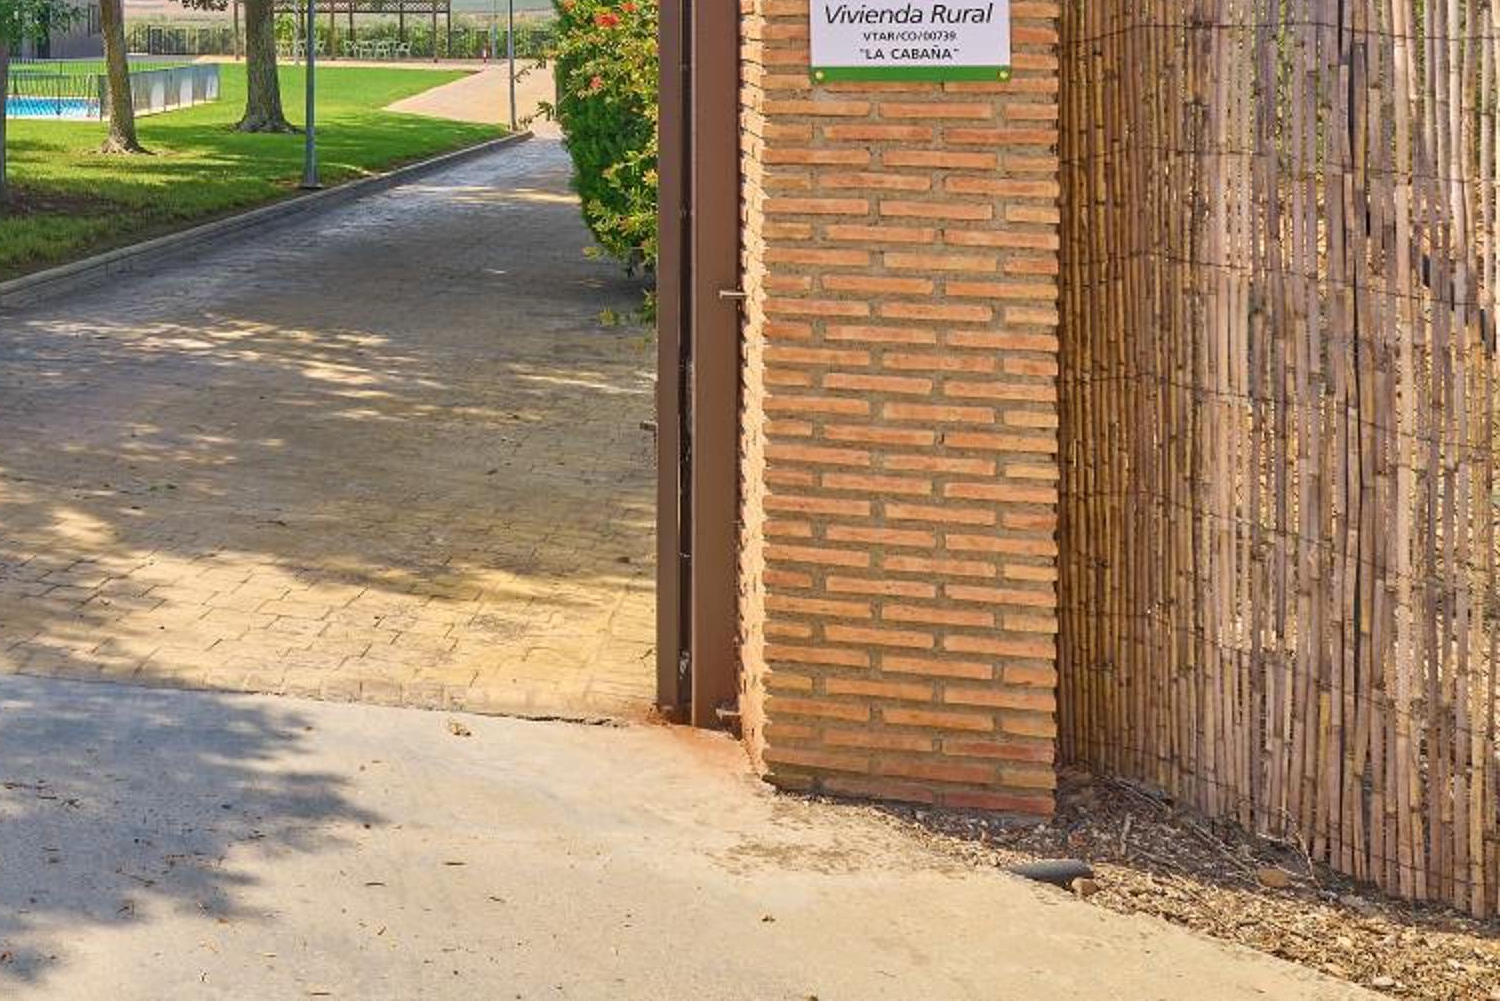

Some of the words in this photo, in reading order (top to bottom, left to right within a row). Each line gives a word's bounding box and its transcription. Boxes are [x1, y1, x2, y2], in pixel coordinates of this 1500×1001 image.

[824, 2, 923, 24] Vivienda
[930, 2, 994, 24] Rural
[863, 30, 957, 42] VTAR/CO/00739
[860, 48, 885, 60] "LA
[891, 44, 960, 60] CABAÑA"
